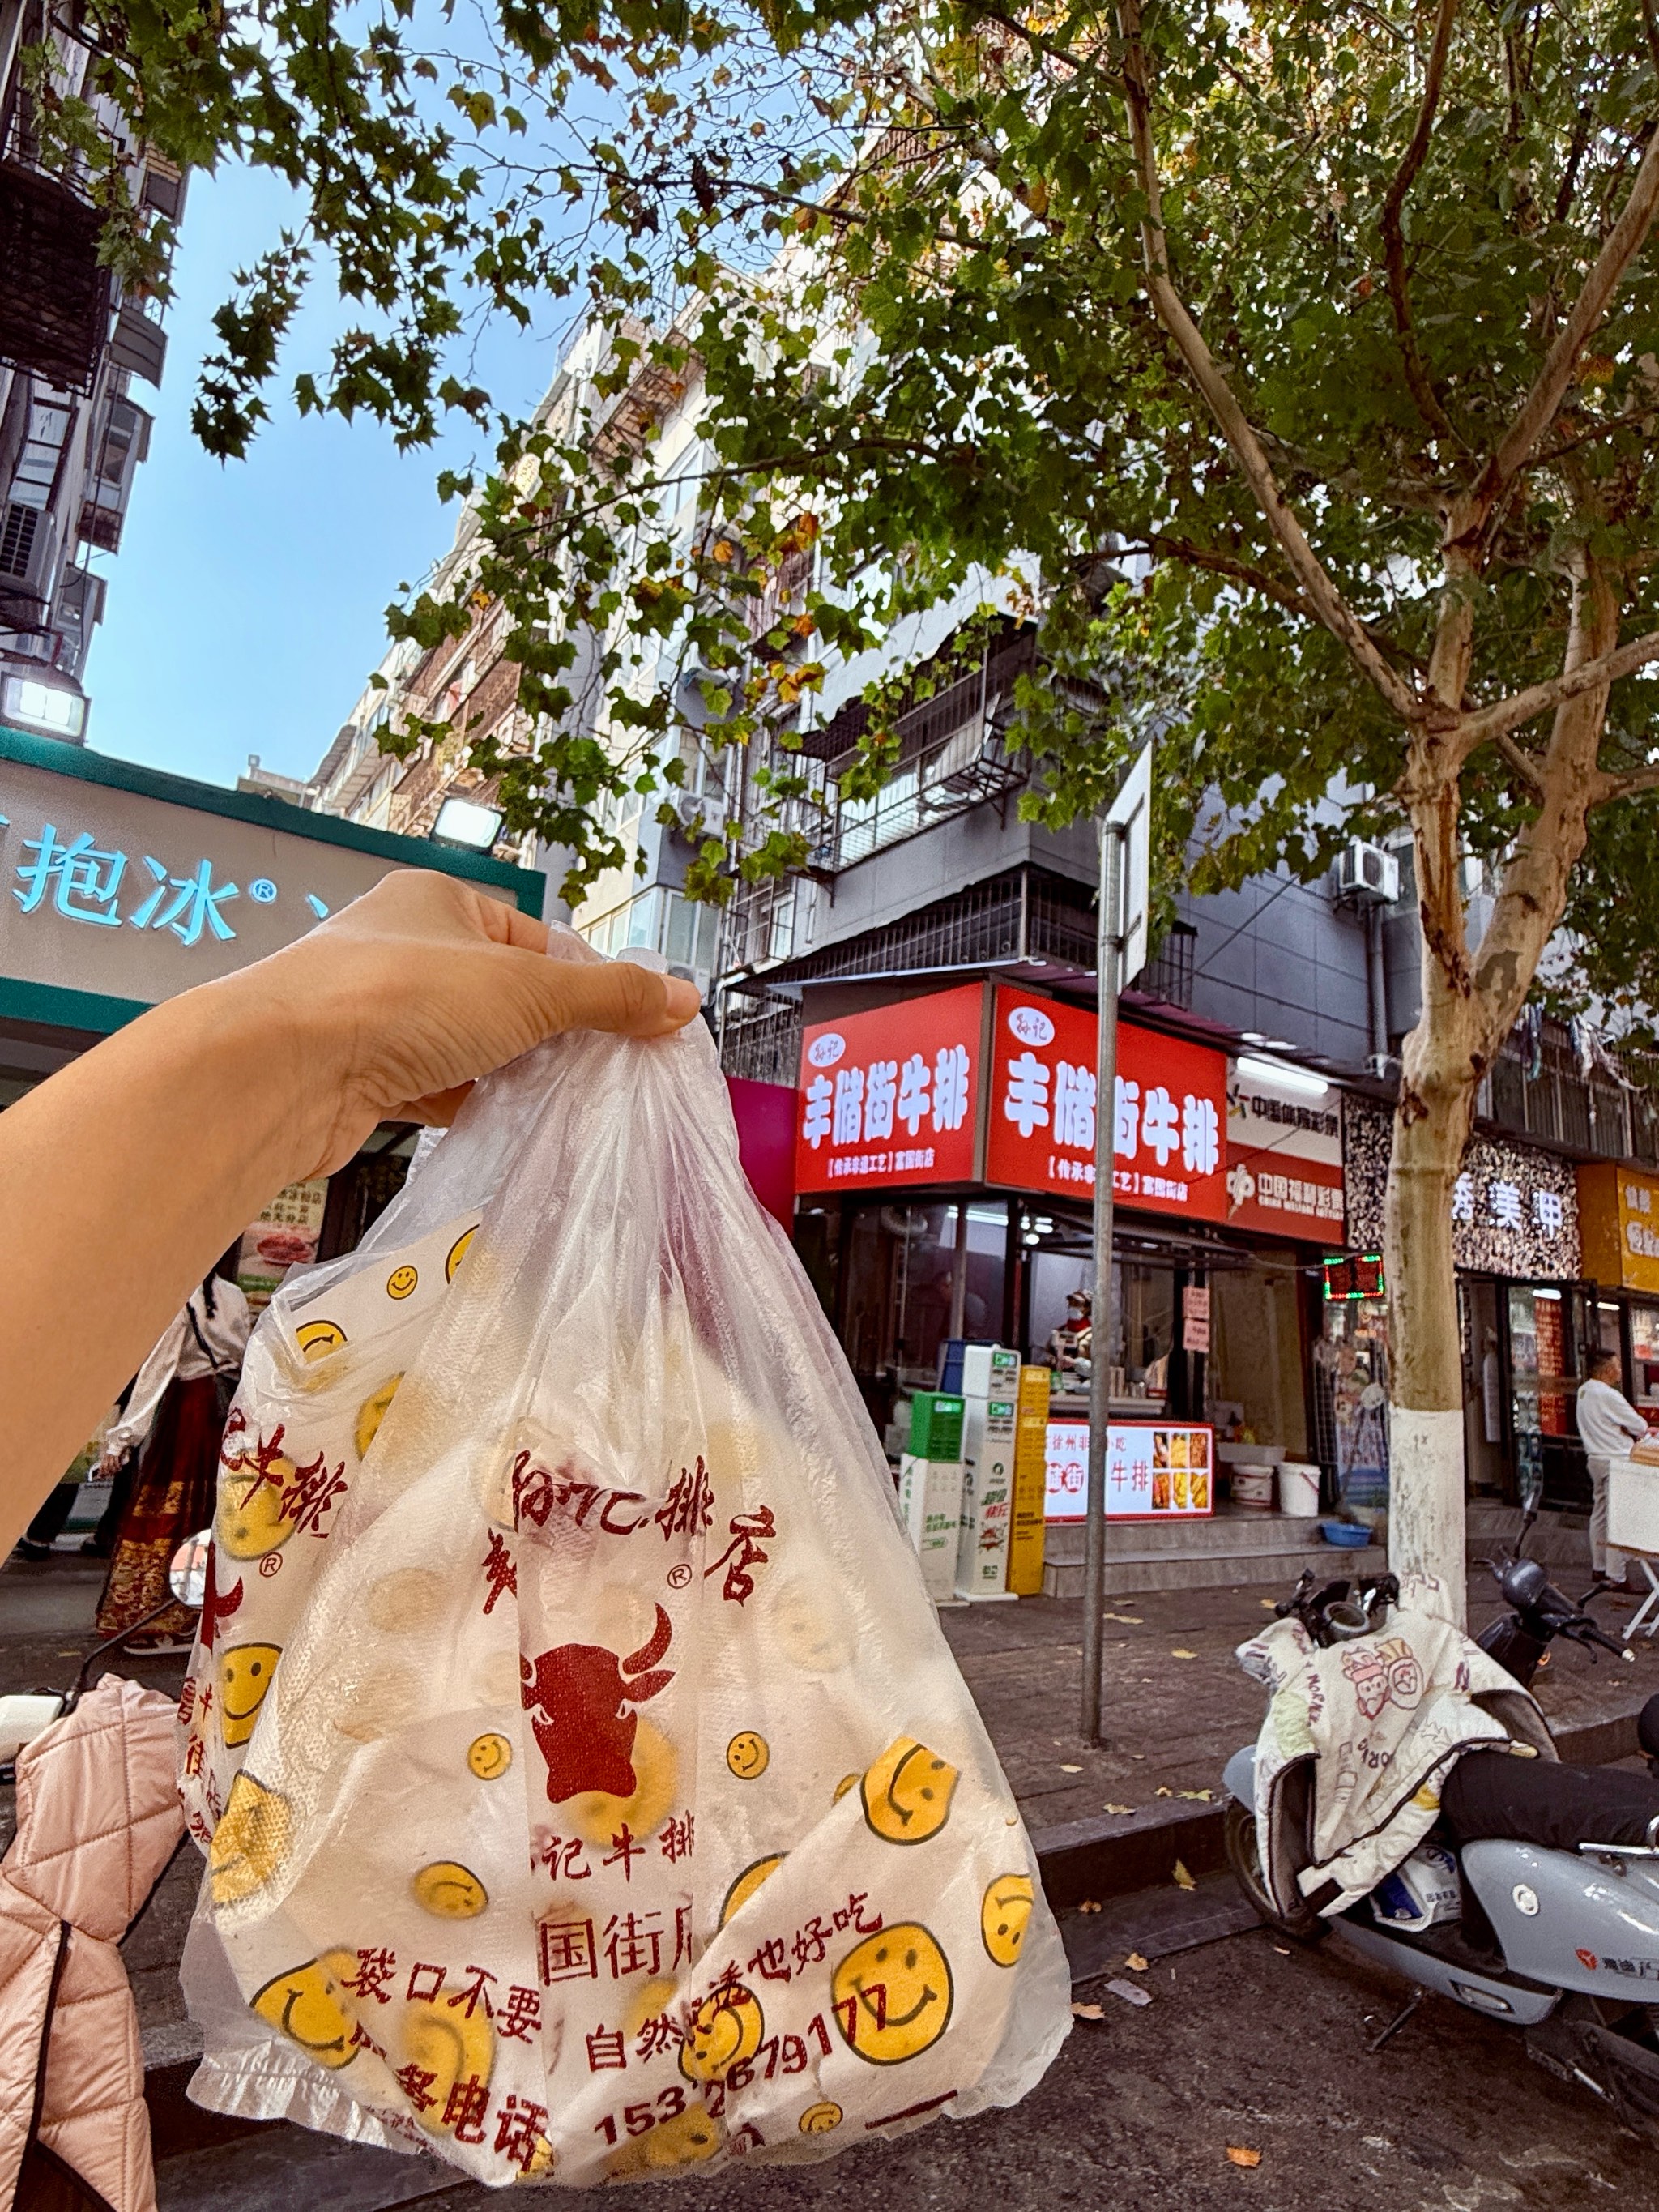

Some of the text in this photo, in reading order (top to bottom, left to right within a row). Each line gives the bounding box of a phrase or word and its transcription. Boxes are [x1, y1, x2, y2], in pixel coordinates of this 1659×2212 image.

[802, 1044, 970, 1150] 丰储街牛排
